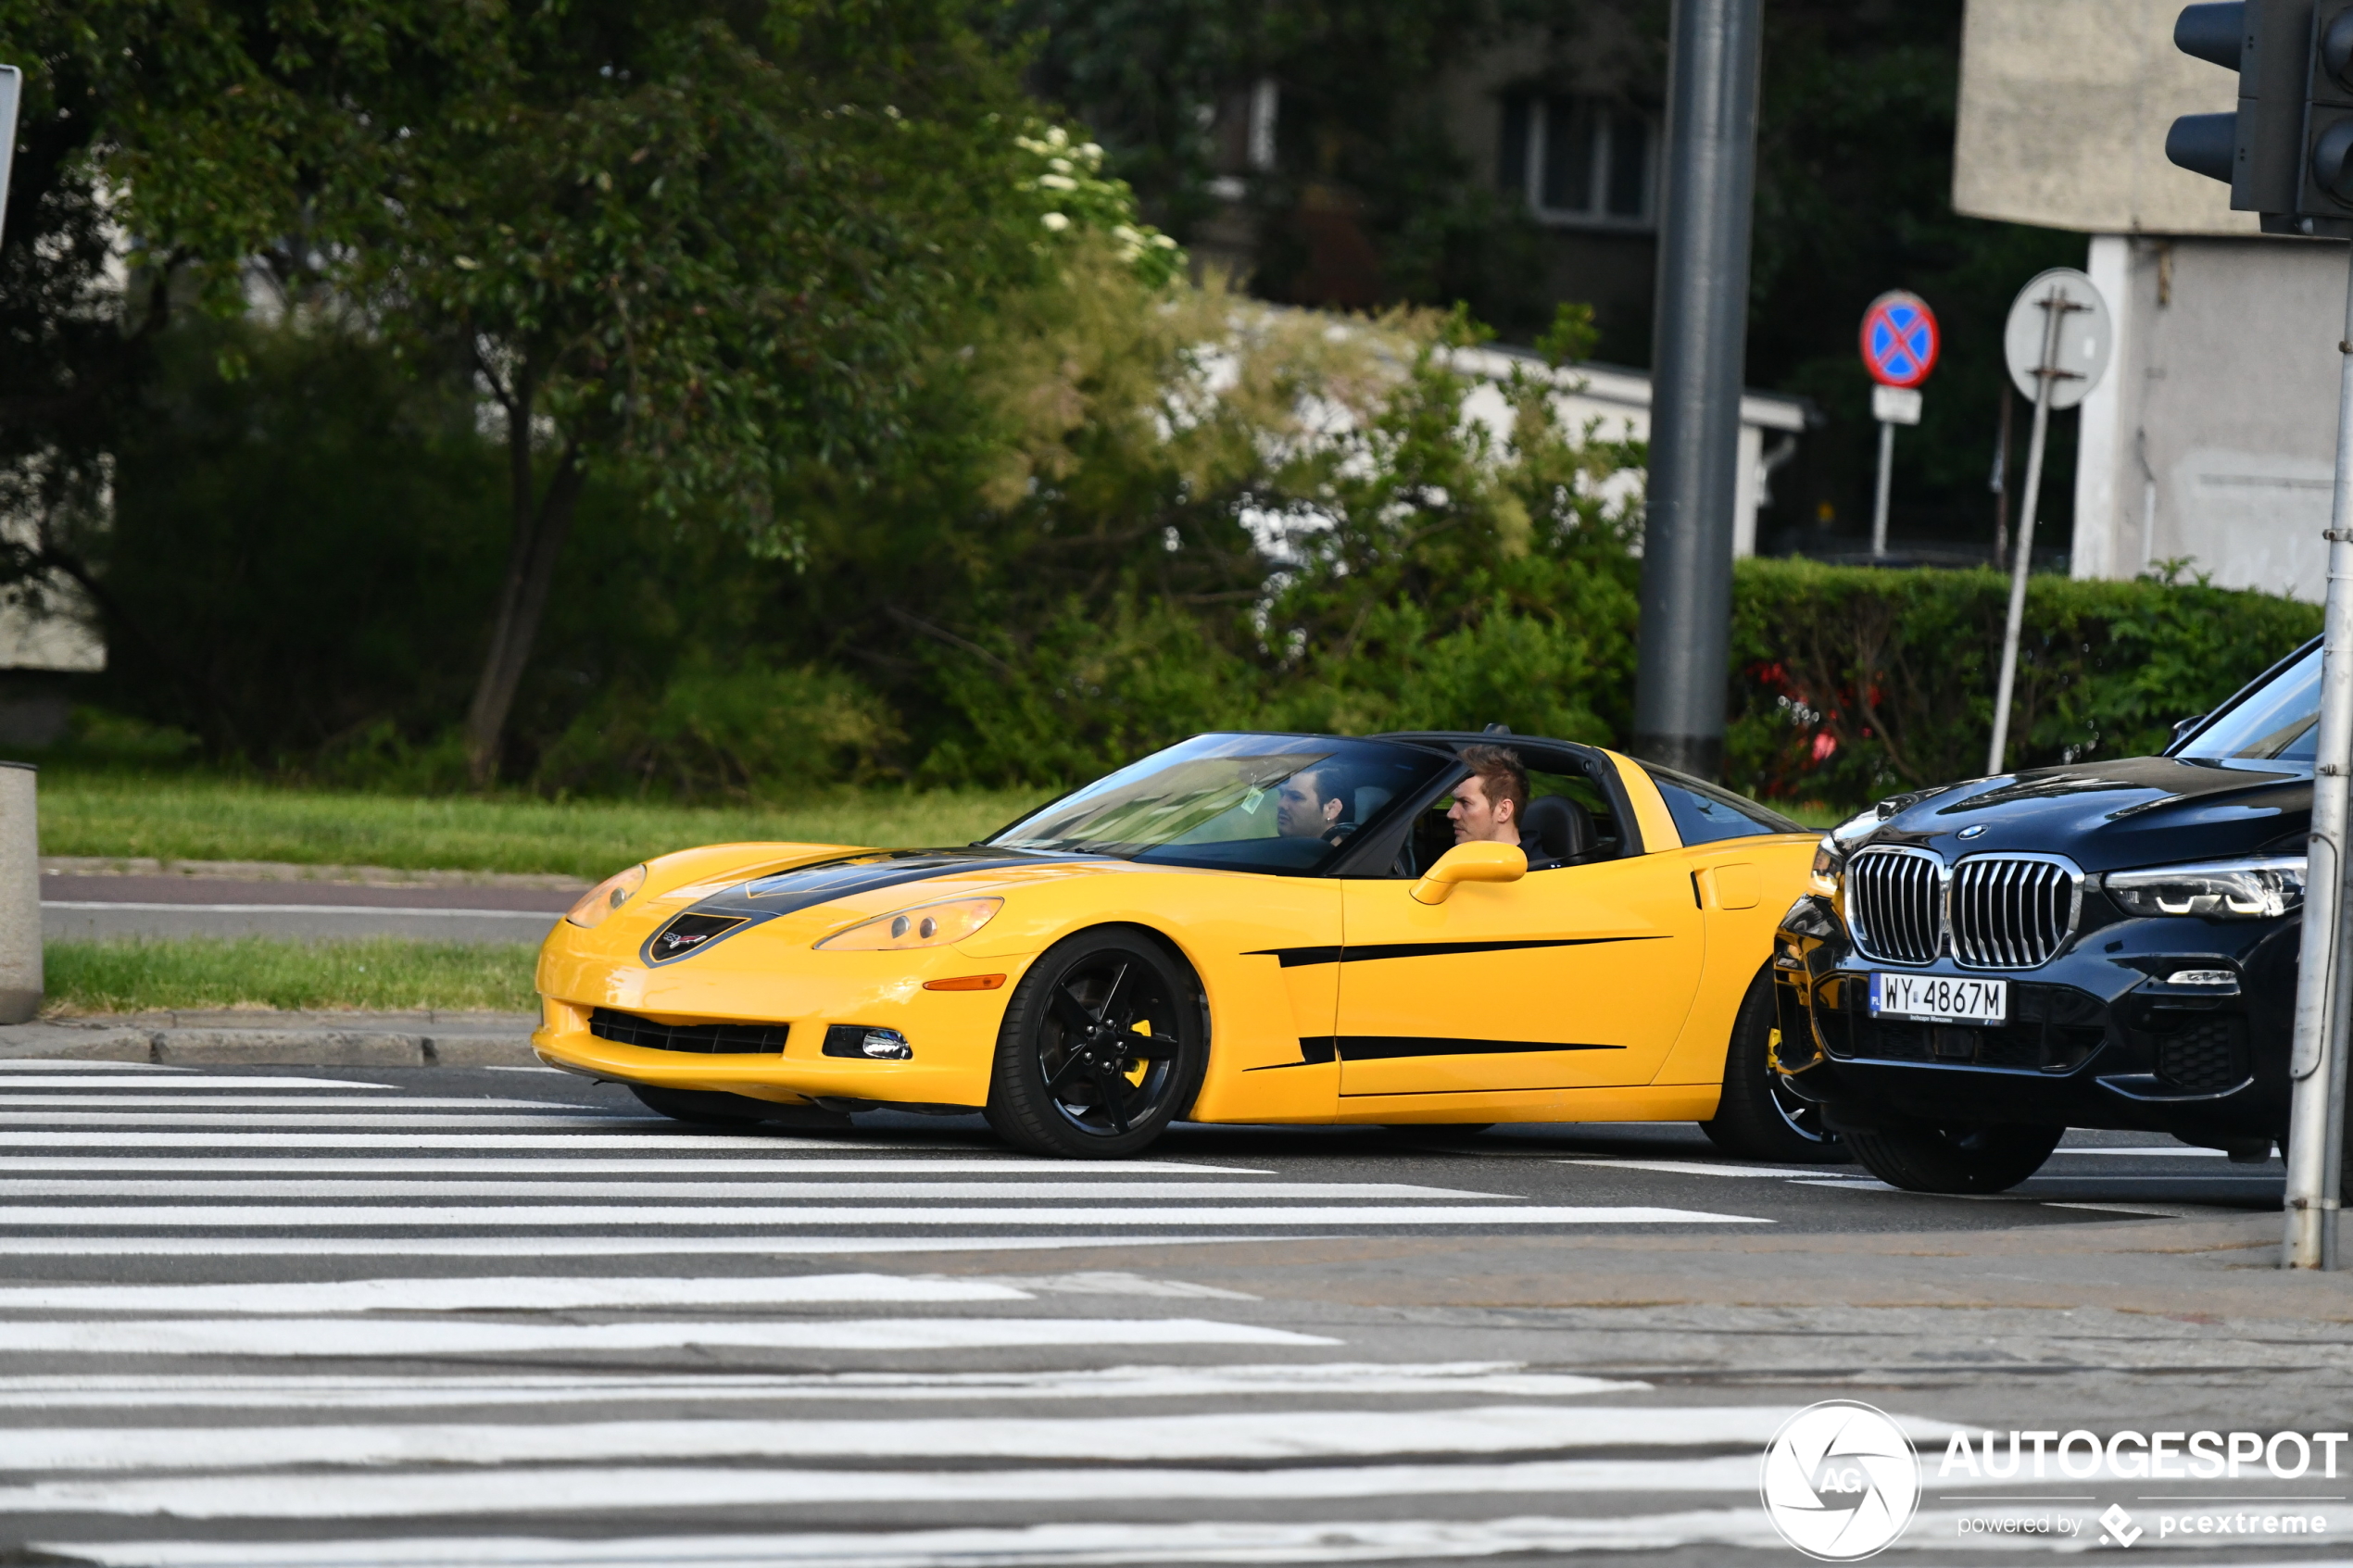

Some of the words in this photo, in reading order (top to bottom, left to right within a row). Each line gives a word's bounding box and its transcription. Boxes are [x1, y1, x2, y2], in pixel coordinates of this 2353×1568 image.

[1871, 997, 1881, 1006] PL
[1886, 977, 1913, 1010] WY
[1923, 980, 1999, 1016] 4867M
